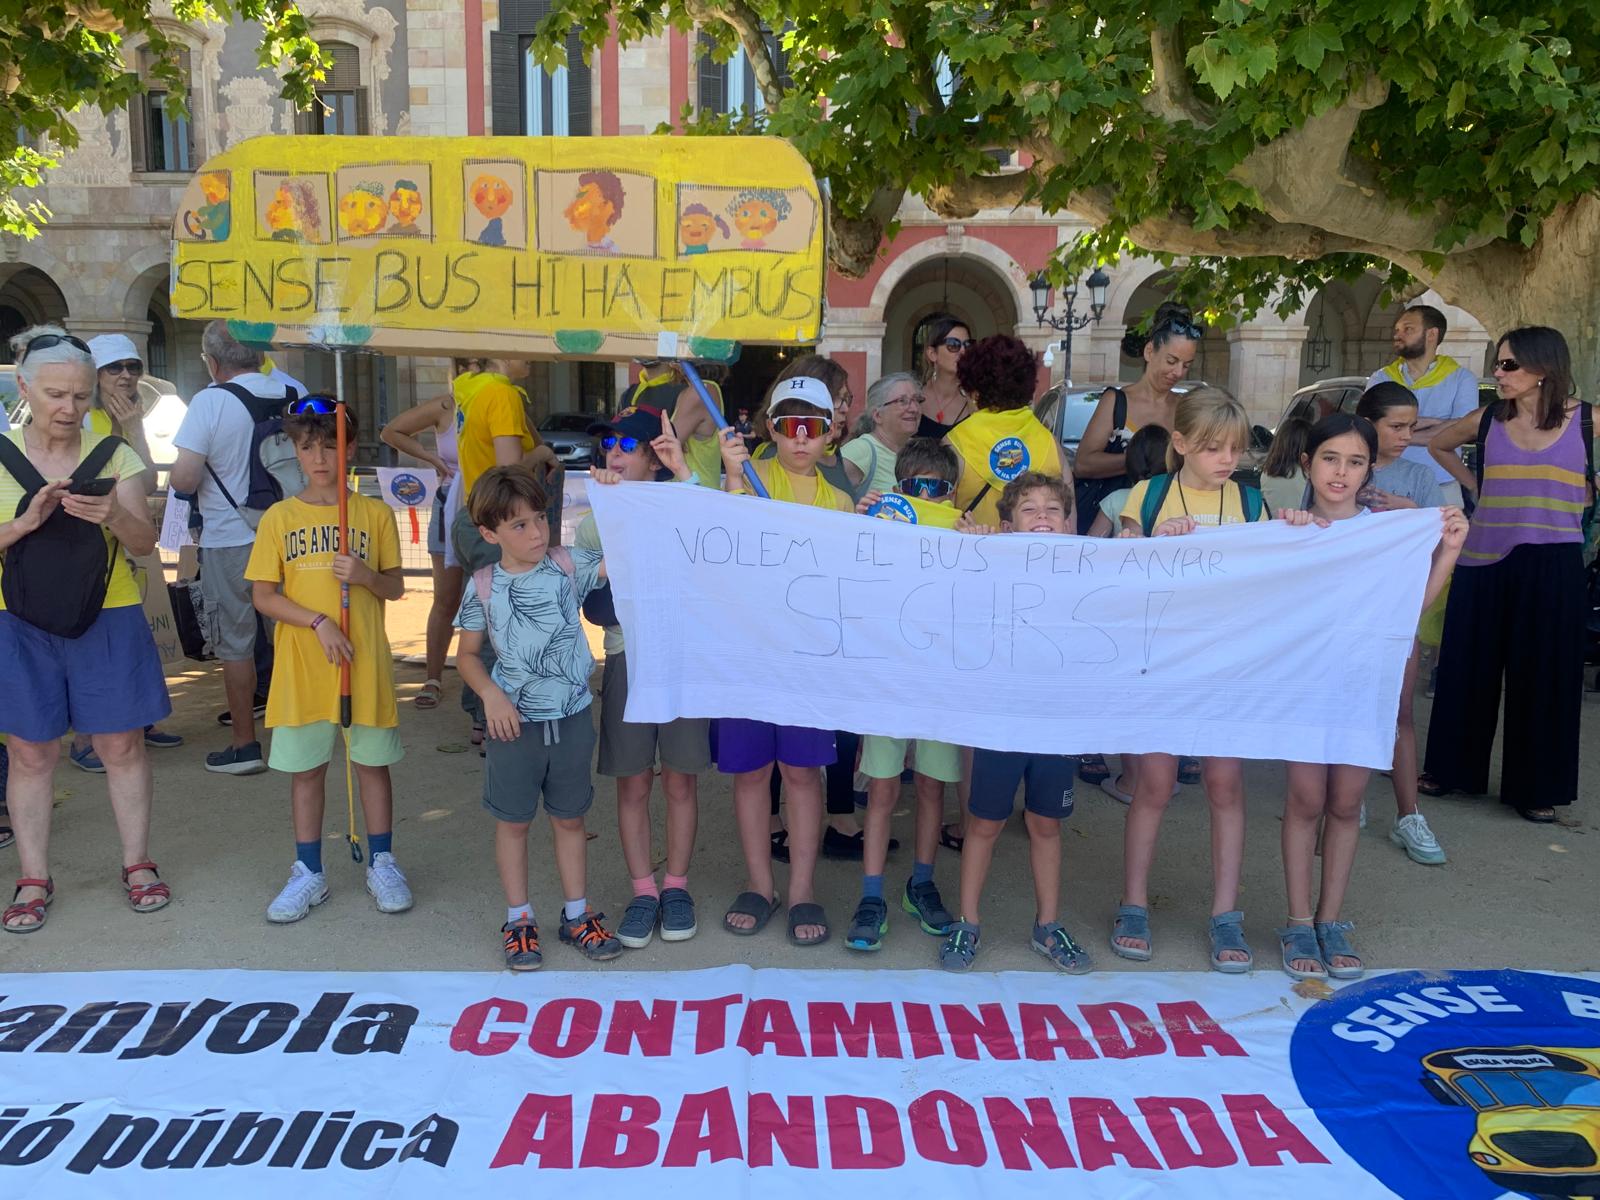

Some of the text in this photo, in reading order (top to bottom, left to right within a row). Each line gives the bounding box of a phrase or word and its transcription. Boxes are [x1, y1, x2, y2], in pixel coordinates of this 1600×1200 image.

[177, 249, 817, 323] SENSE BUS HI HA EMBÚS
[310, 525, 370, 560] ANGLE
[902, 504, 914, 519] BUS
[675, 526, 1228, 579] VOLEM EL BUS PER ANAR
[785, 574, 1176, 675] SEGURS!
[0, 992, 1249, 1061] anyola CONTAMINADA
[1331, 984, 1524, 1053] SENSE
[64, 1109, 460, 1175] pública
[489, 1086, 1332, 1172] ABANDONADA
